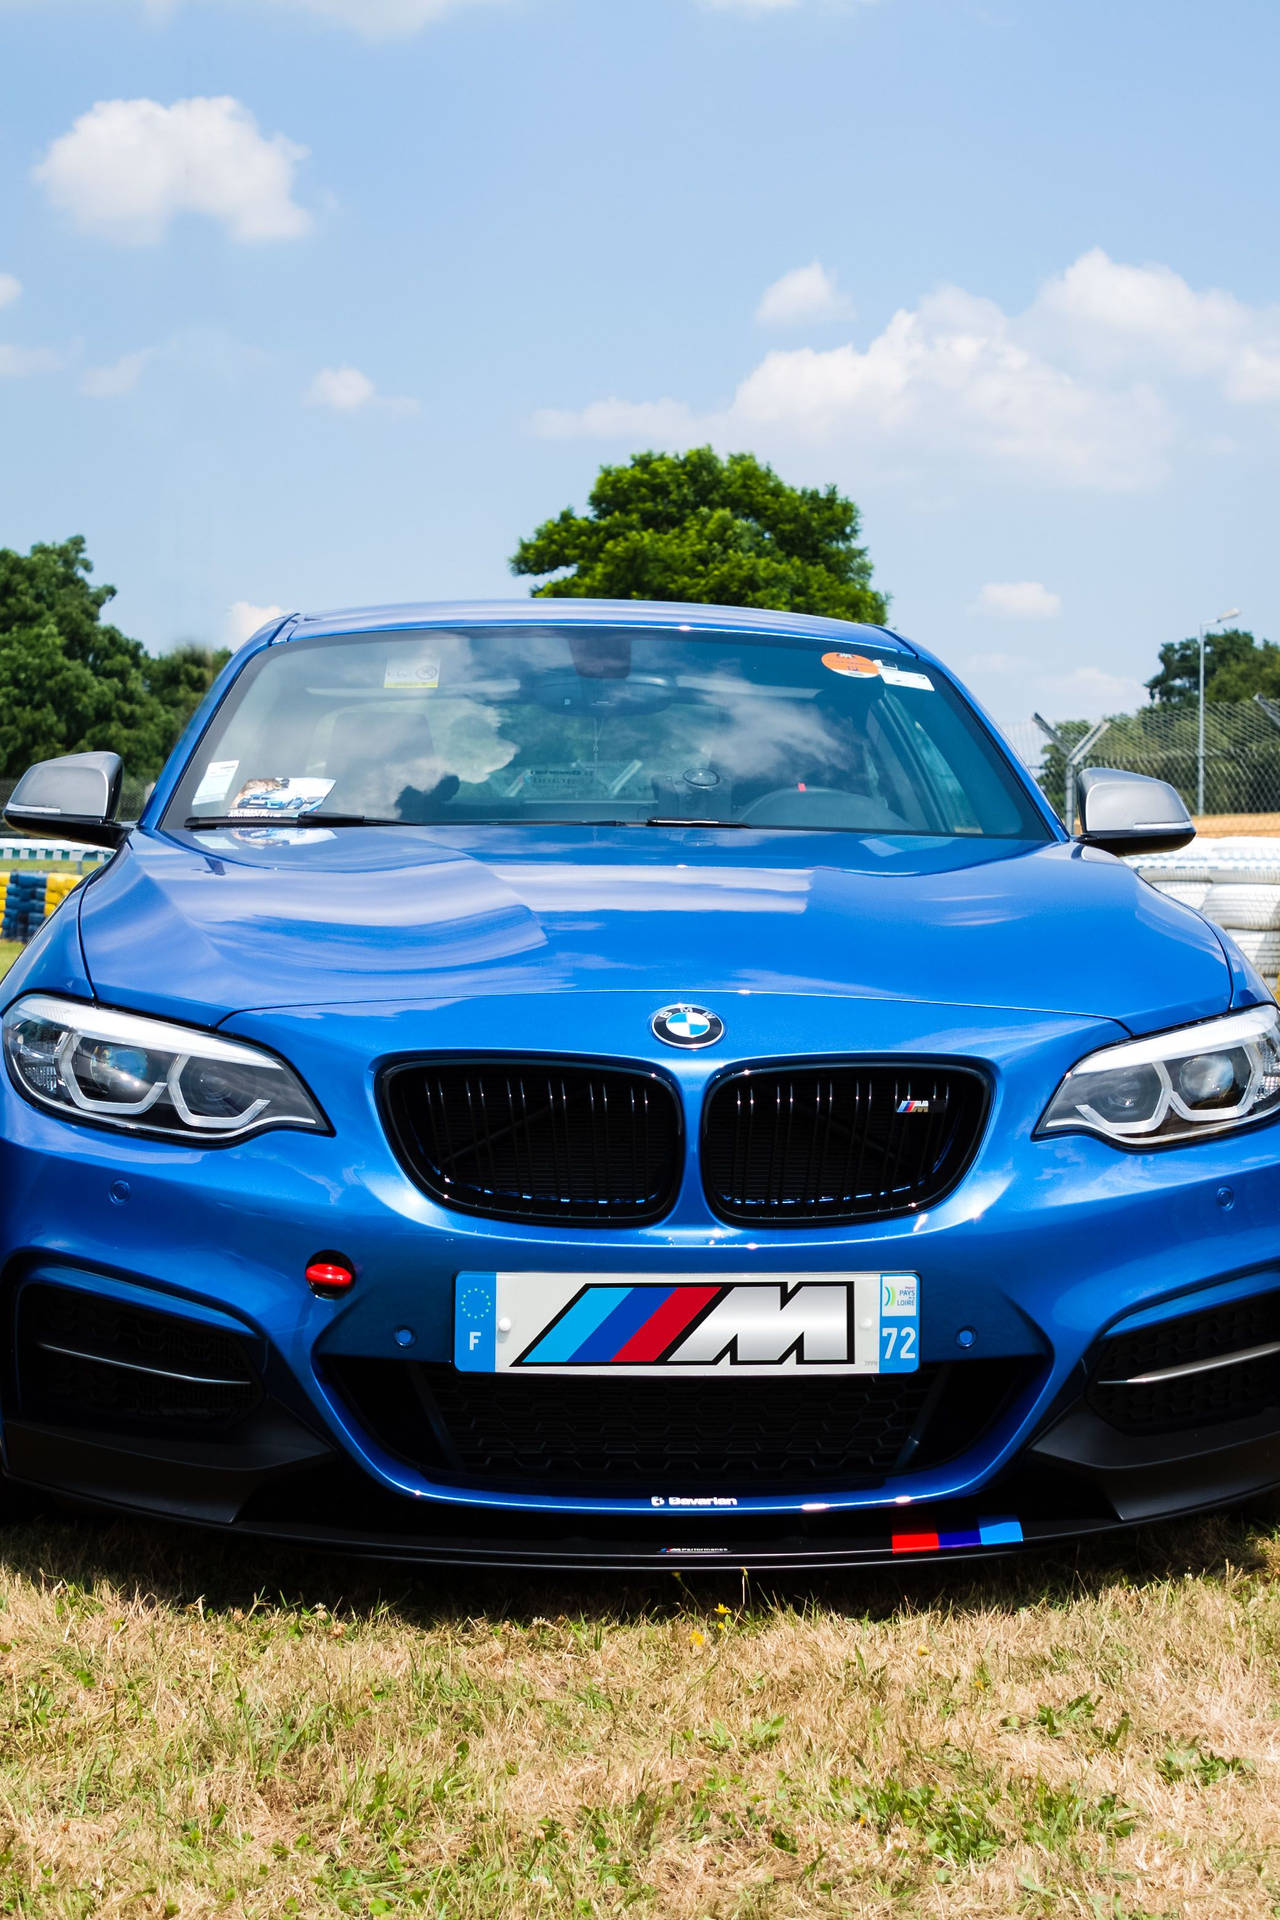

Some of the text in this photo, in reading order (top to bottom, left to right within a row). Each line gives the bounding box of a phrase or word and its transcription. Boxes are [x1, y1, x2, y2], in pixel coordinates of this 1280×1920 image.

[660, 1006, 716, 1019] BMW
[899, 1289, 916, 1297] PAYS
[896, 1299, 915, 1307] LOIRE
[660, 1281, 855, 1365] M
[469, 1331, 482, 1351] F
[882, 1326, 917, 1360] 72
